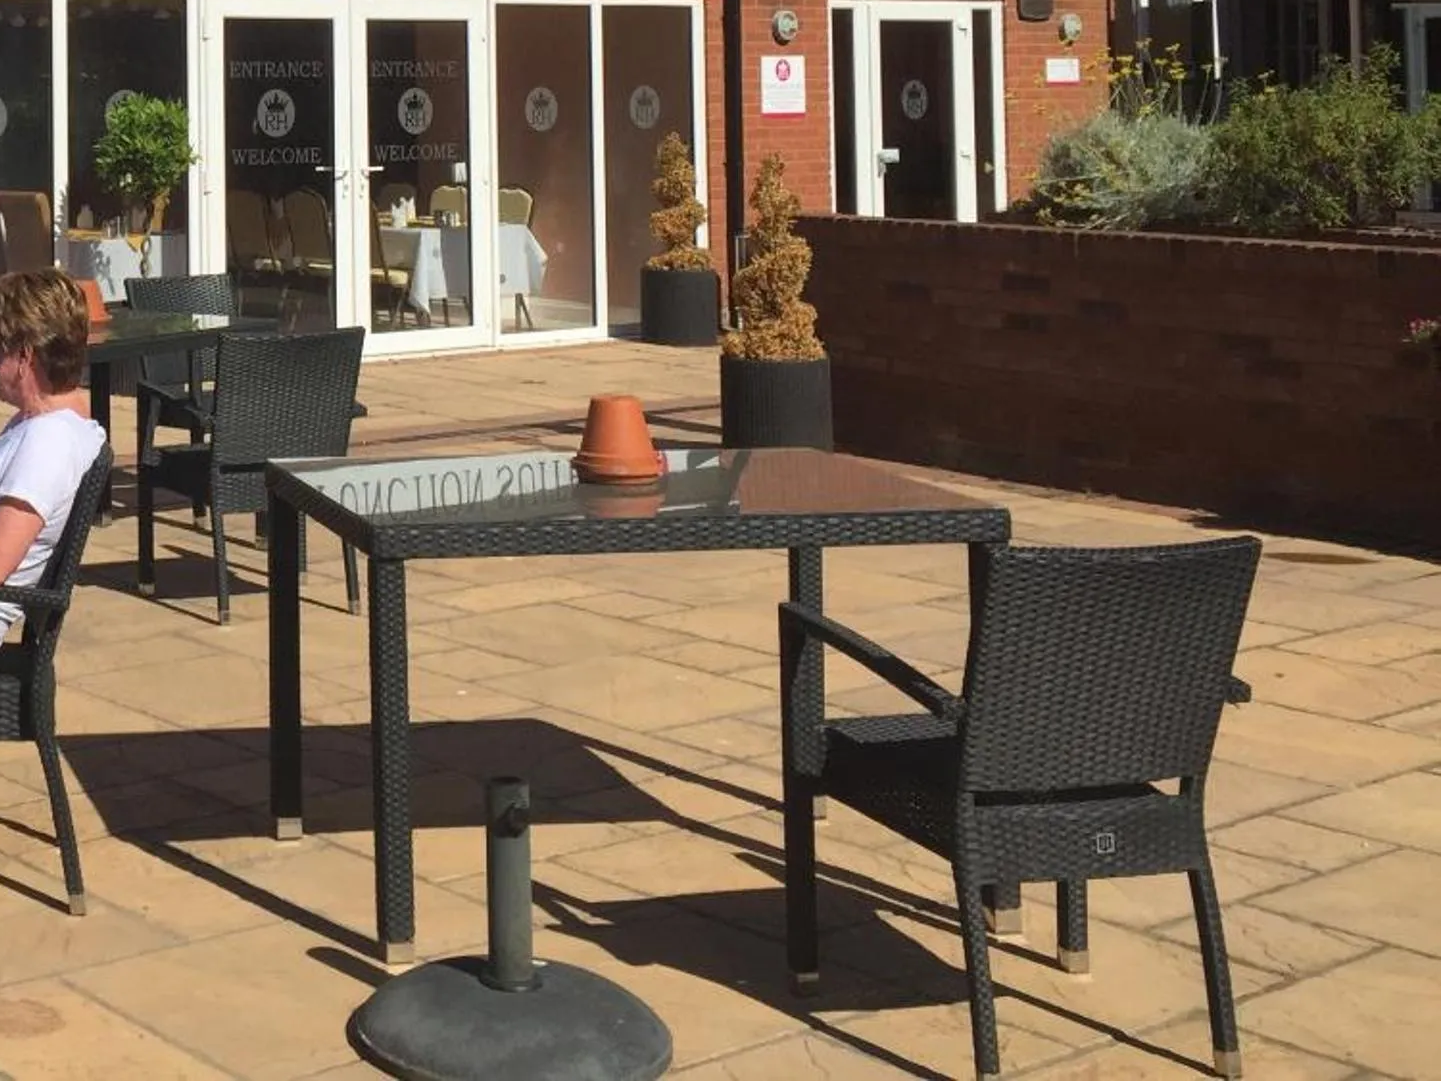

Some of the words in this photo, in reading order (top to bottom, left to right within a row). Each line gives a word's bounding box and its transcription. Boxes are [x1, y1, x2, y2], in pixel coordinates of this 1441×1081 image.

[230, 60, 324, 79] ENTRANCE
[372, 60, 459, 79] ENTRANCE
[264, 113, 289, 132] RH
[232, 147, 323, 166] WELCOME
[374, 143, 458, 162] WELCOME
